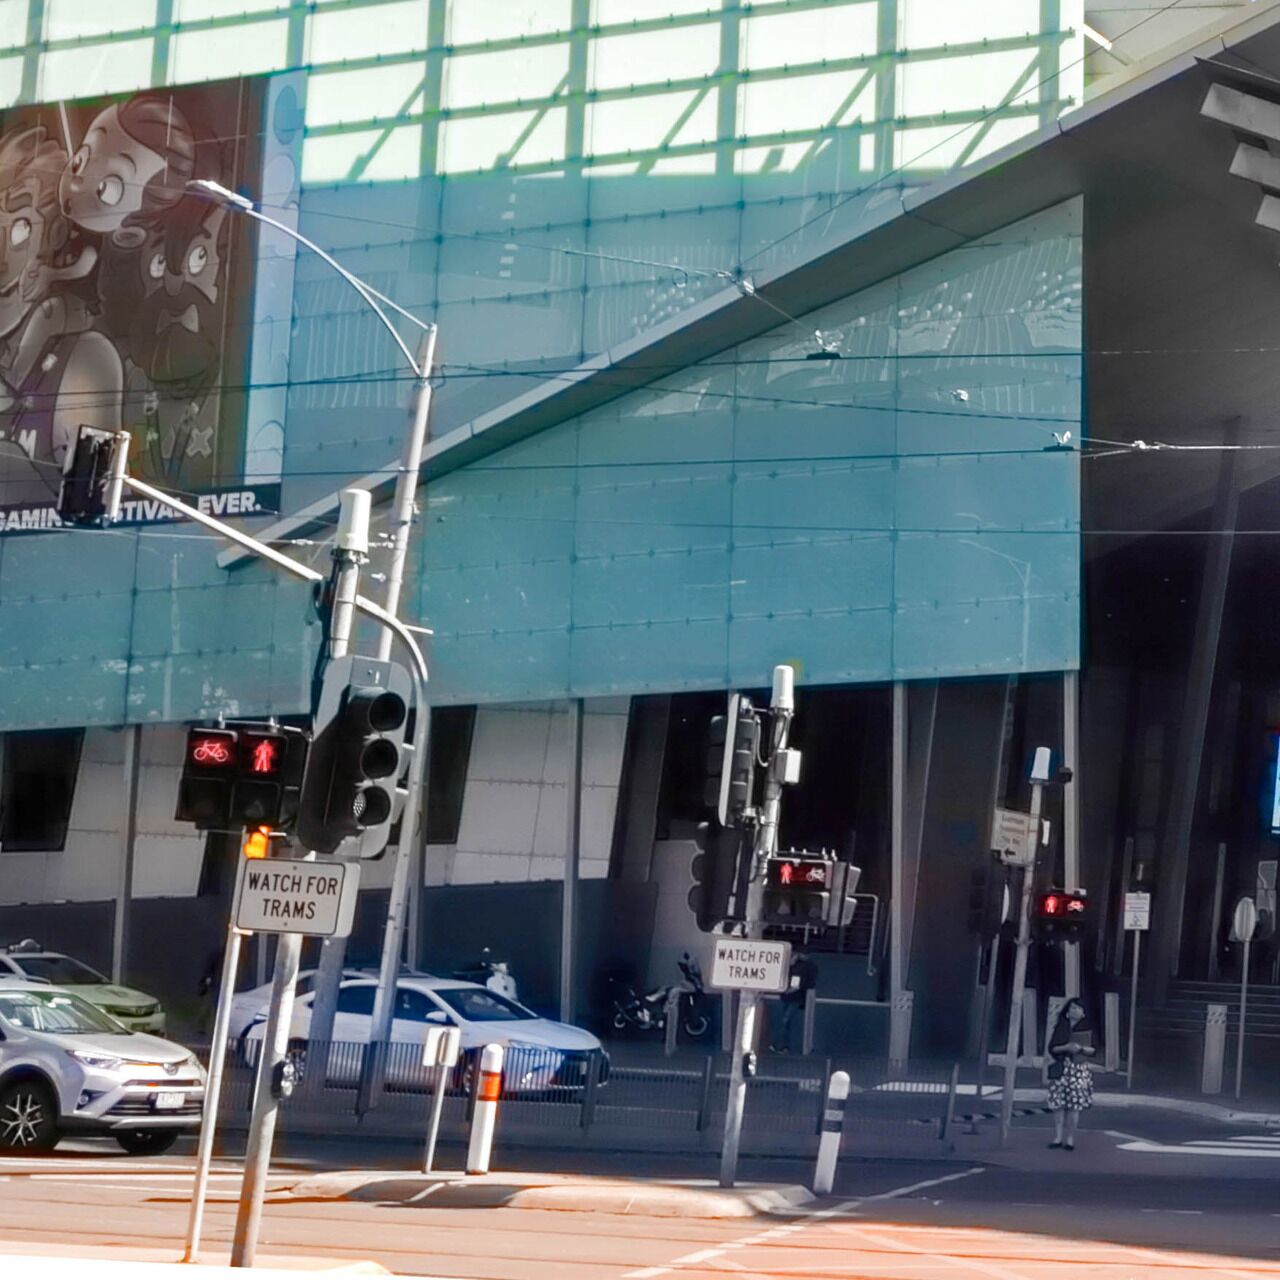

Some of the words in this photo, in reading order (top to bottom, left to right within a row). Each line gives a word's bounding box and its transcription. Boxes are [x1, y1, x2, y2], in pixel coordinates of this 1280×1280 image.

[198, 491, 261, 516] EVER.
[248, 872, 303, 893] WATCH
[306, 876, 338, 895] FOR
[262, 898, 316, 920] TRAMS
[718, 949, 756, 962] WATCH
[759, 951, 781, 964] FOR
[729, 965, 767, 980] TRAMS
